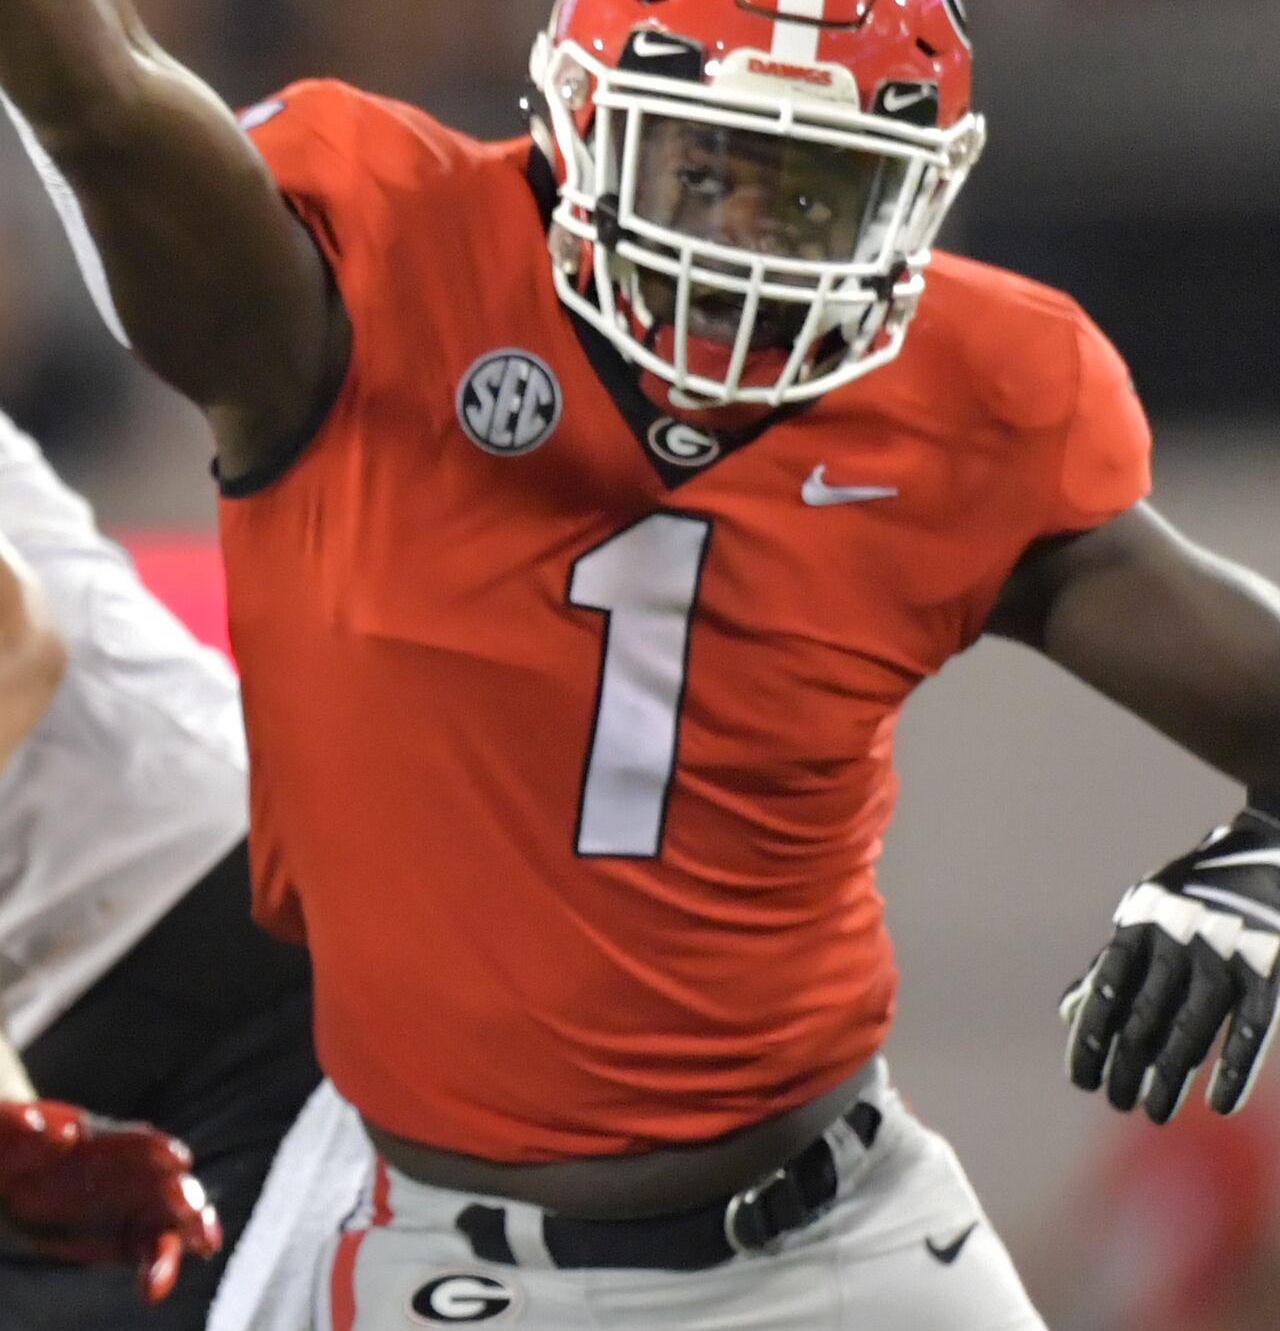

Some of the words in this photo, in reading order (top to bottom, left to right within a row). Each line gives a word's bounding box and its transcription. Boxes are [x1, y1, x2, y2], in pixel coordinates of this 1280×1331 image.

[463, 355, 556, 449] SEC
[569, 509, 713, 858] 1
[420, 1275, 513, 1321] G
